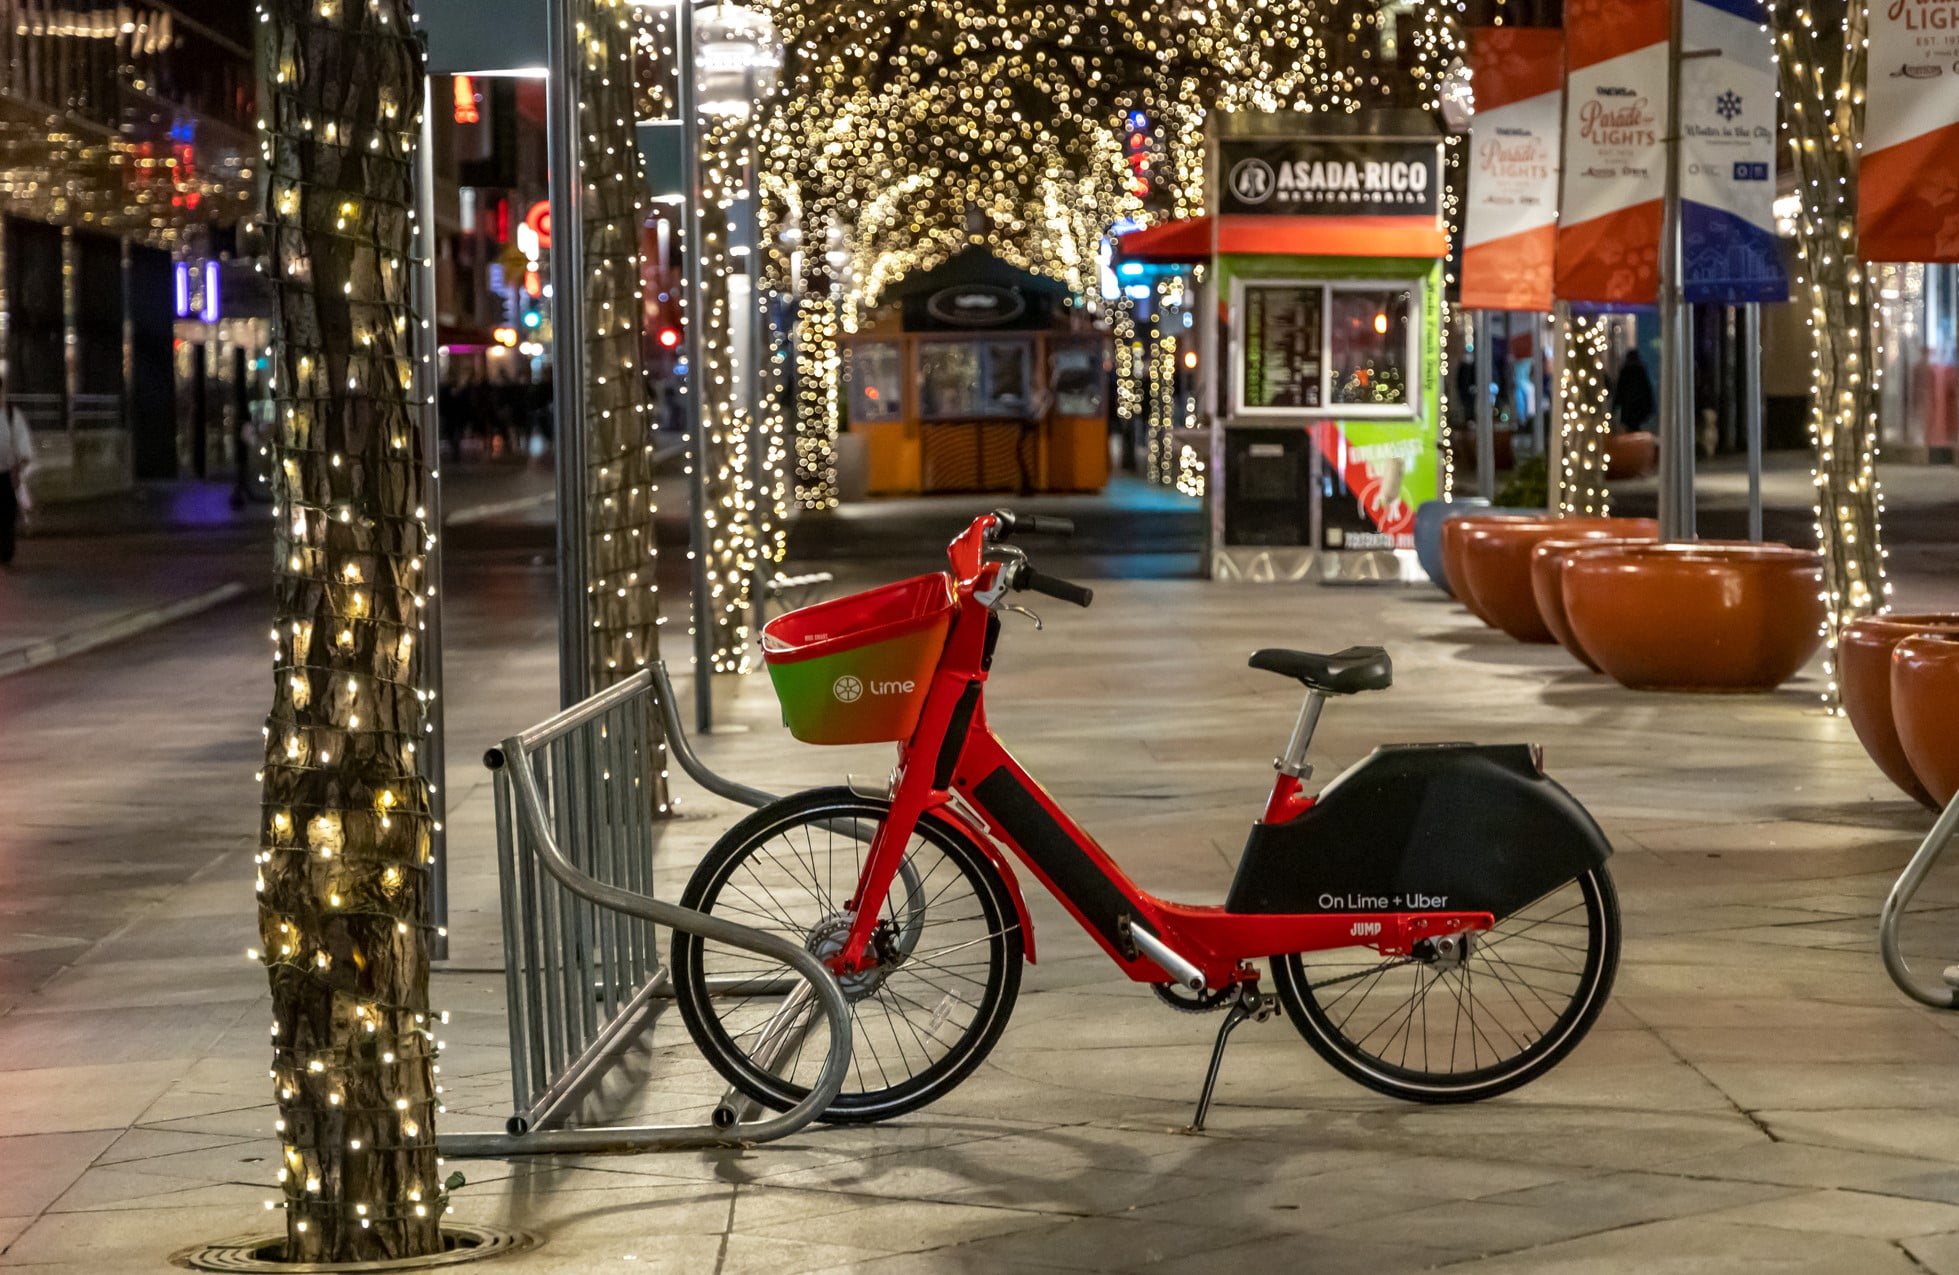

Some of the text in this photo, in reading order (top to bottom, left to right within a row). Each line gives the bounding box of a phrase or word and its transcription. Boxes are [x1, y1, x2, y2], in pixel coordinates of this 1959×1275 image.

[1592, 130, 1655, 146] LIGHTS
[870, 680, 915, 695] Lime
[1318, 893, 1344, 909] On
[1348, 893, 1389, 909] Lime
[1406, 893, 1448, 909] Uber
[1350, 922, 1381, 936] JUMP
